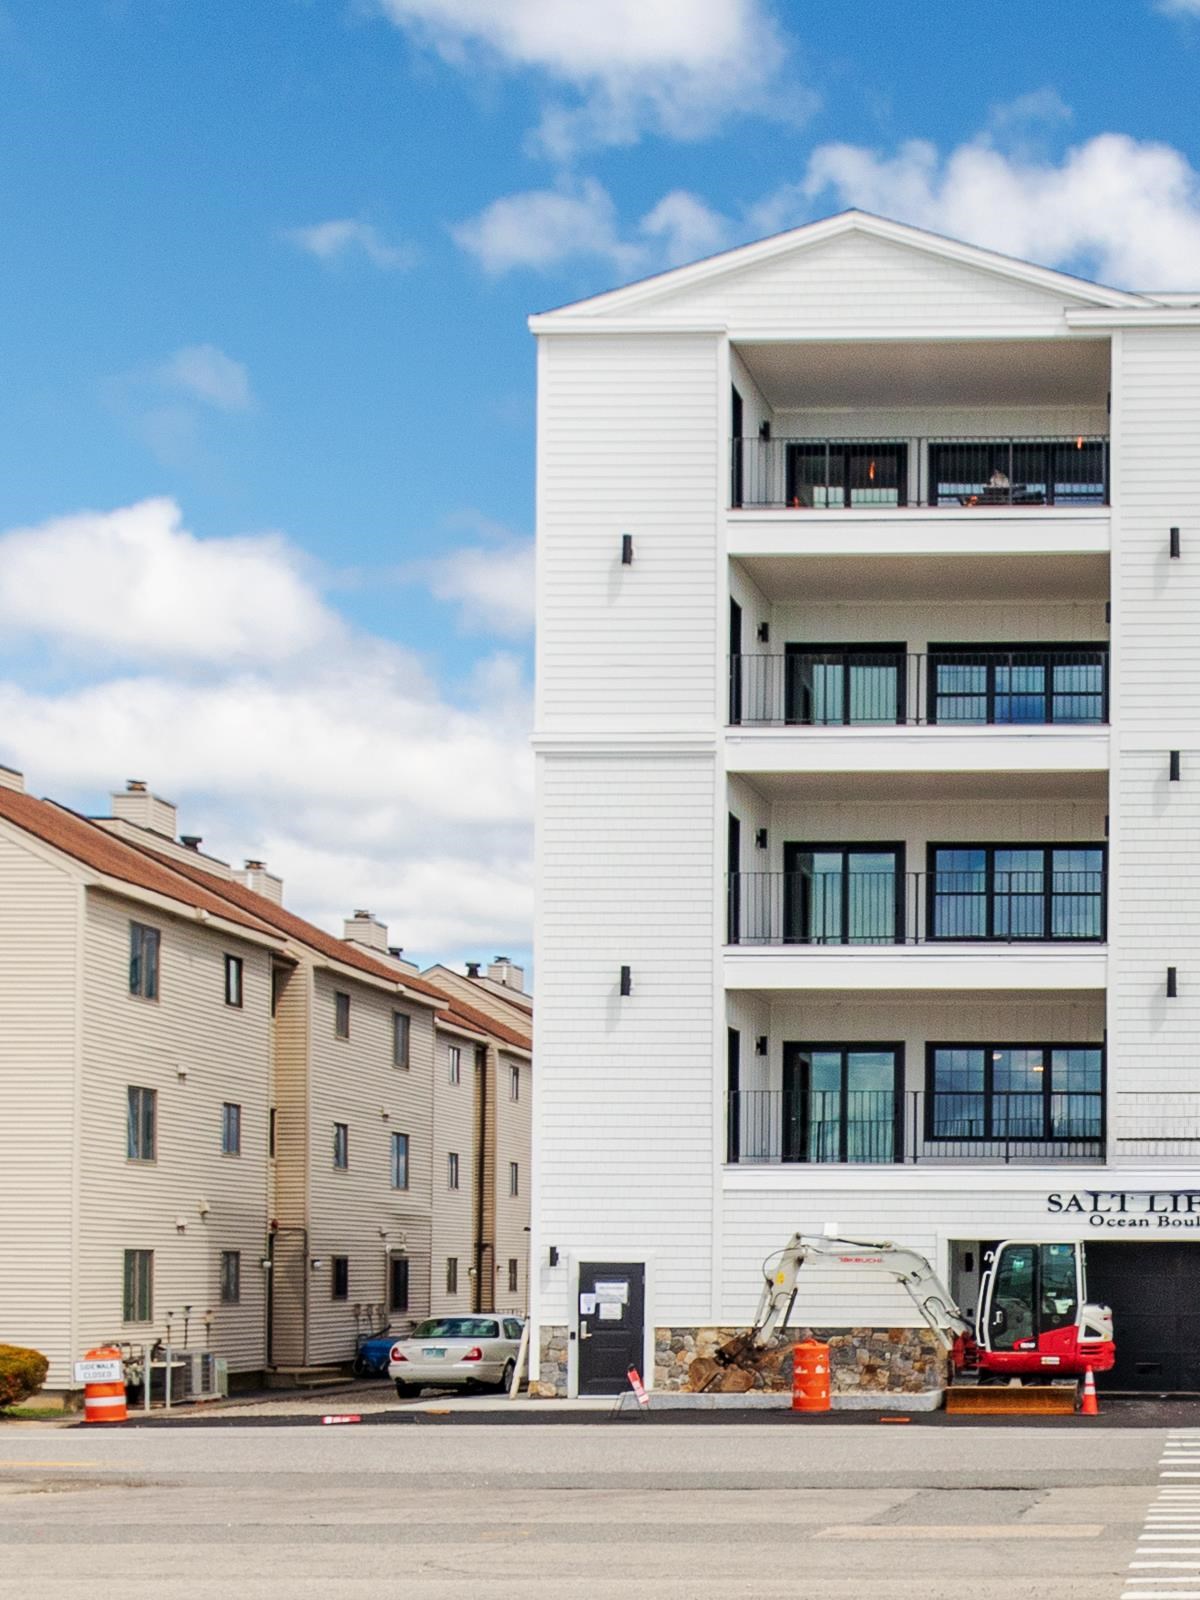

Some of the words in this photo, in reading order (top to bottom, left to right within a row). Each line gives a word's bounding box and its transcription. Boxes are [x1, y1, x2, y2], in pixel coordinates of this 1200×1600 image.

[1047, 1193, 1135, 1213] SALT
[1089, 1214, 1150, 1228] Ocean
[83, 1371, 113, 1379] CLOSED
